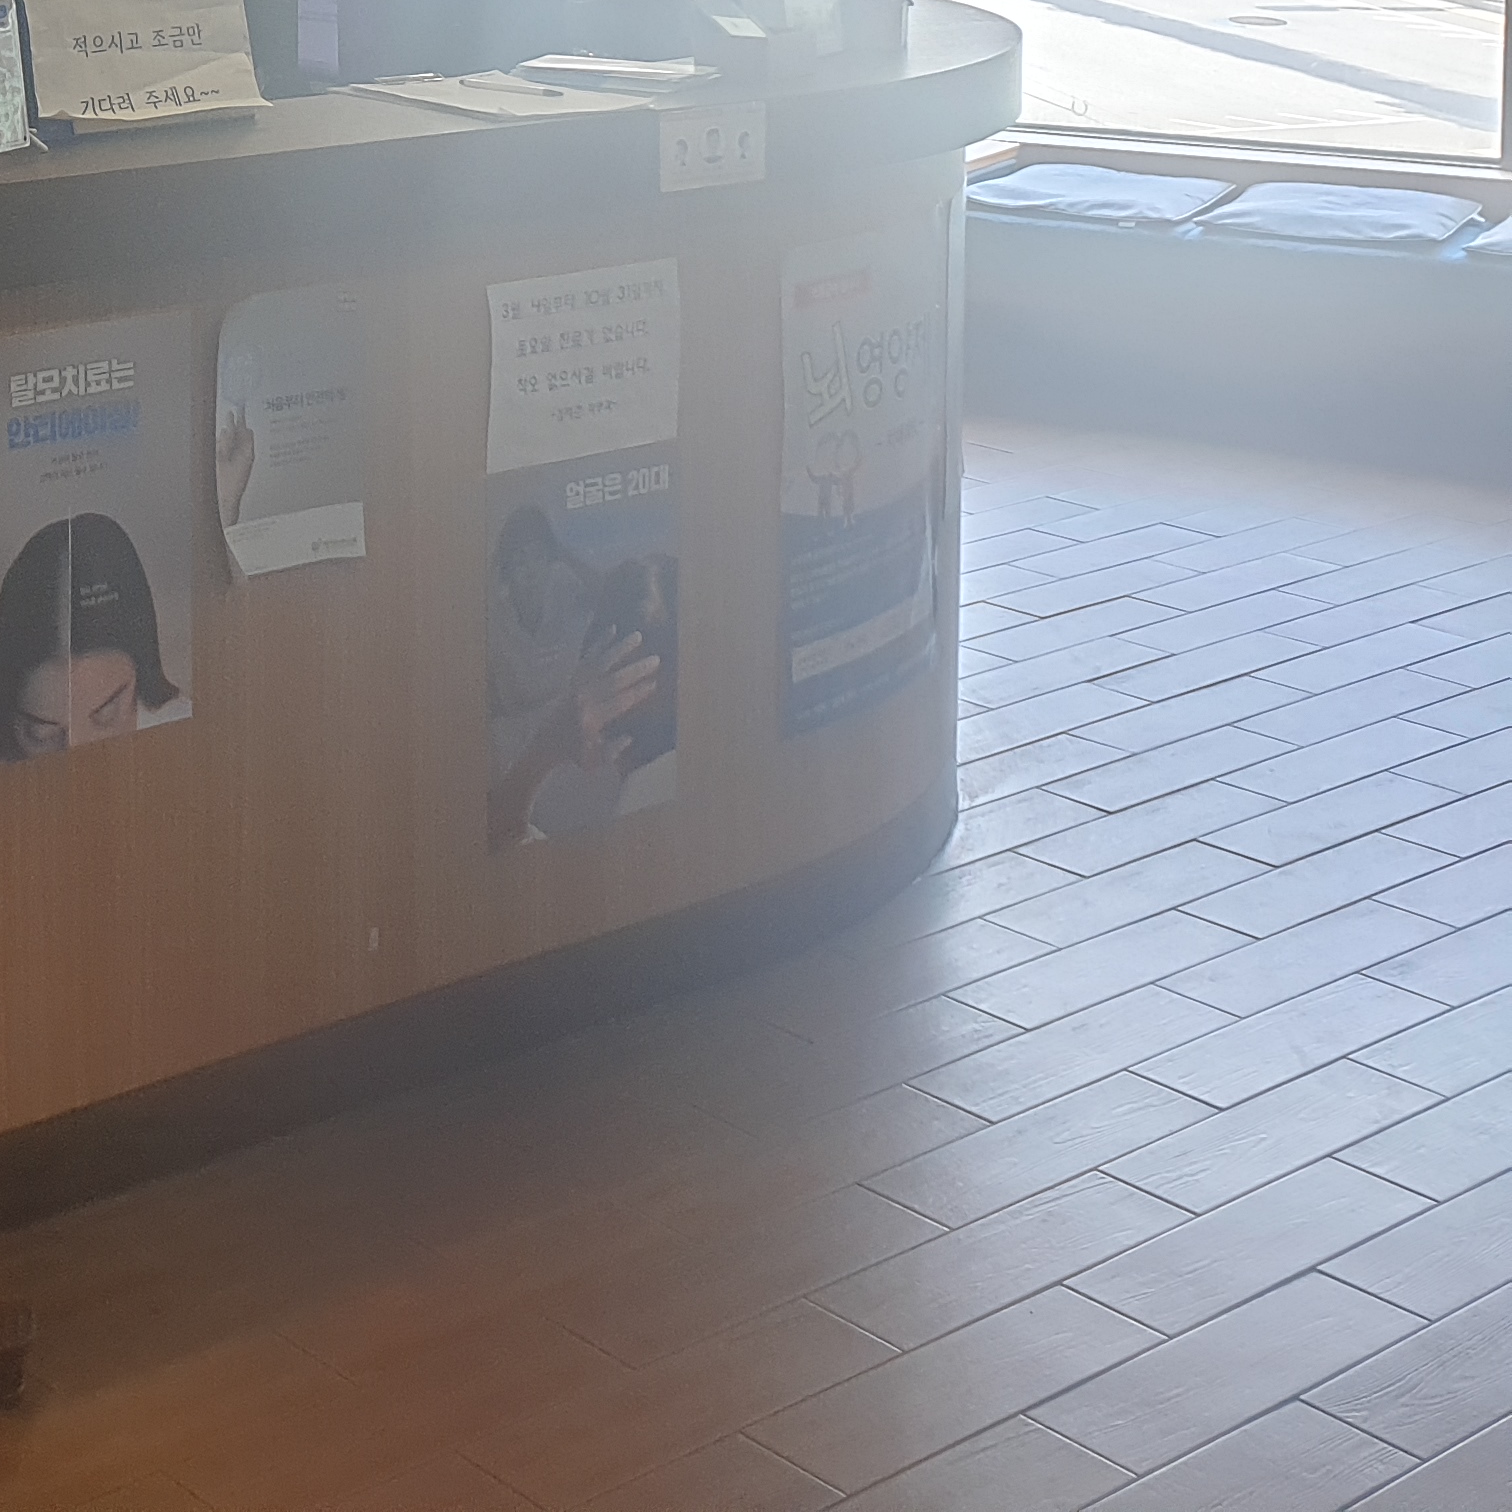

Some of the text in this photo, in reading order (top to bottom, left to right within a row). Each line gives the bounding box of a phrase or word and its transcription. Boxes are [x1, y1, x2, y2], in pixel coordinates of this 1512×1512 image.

[72, 23, 204, 58] 적으시고 조금만
[80, 91, 136, 117] 기다려
[531, 292, 576, 316] 4일부터
[9, 358, 136, 408] 탈모치료는
[566, 463, 670, 510] 얼굴은 20대
